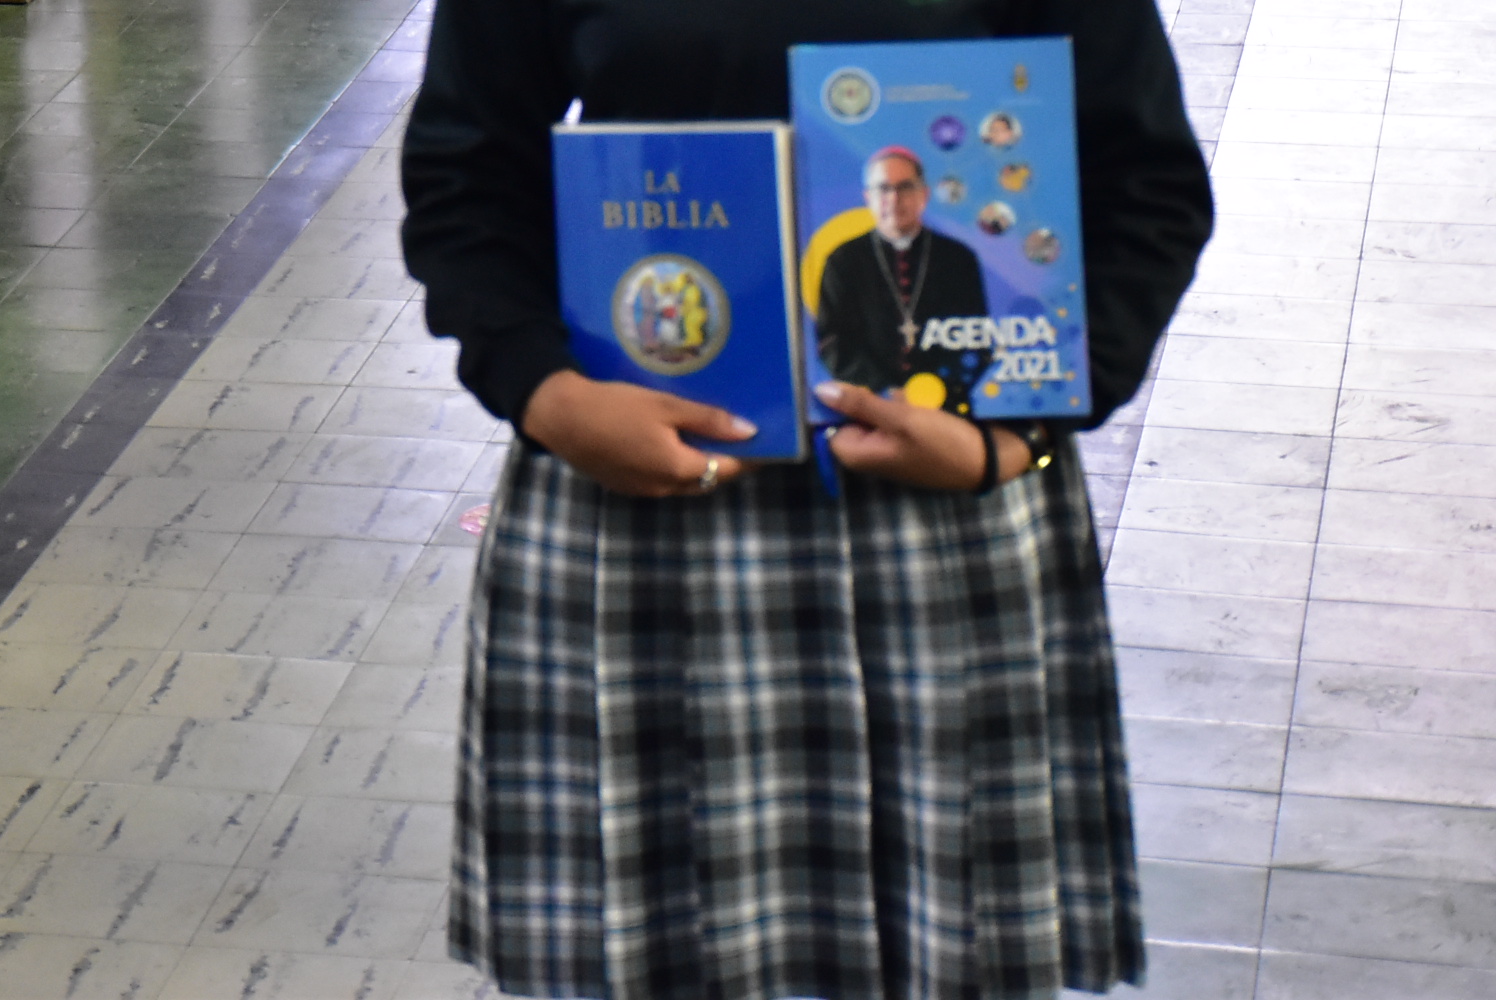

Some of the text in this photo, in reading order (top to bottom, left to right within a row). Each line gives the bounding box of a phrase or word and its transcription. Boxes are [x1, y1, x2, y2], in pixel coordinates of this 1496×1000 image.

[645, 169, 681, 194] LA
[602, 199, 730, 230] BIBLIA
[920, 316, 1056, 351] AGENDA
[992, 350, 1063, 381] 2021
